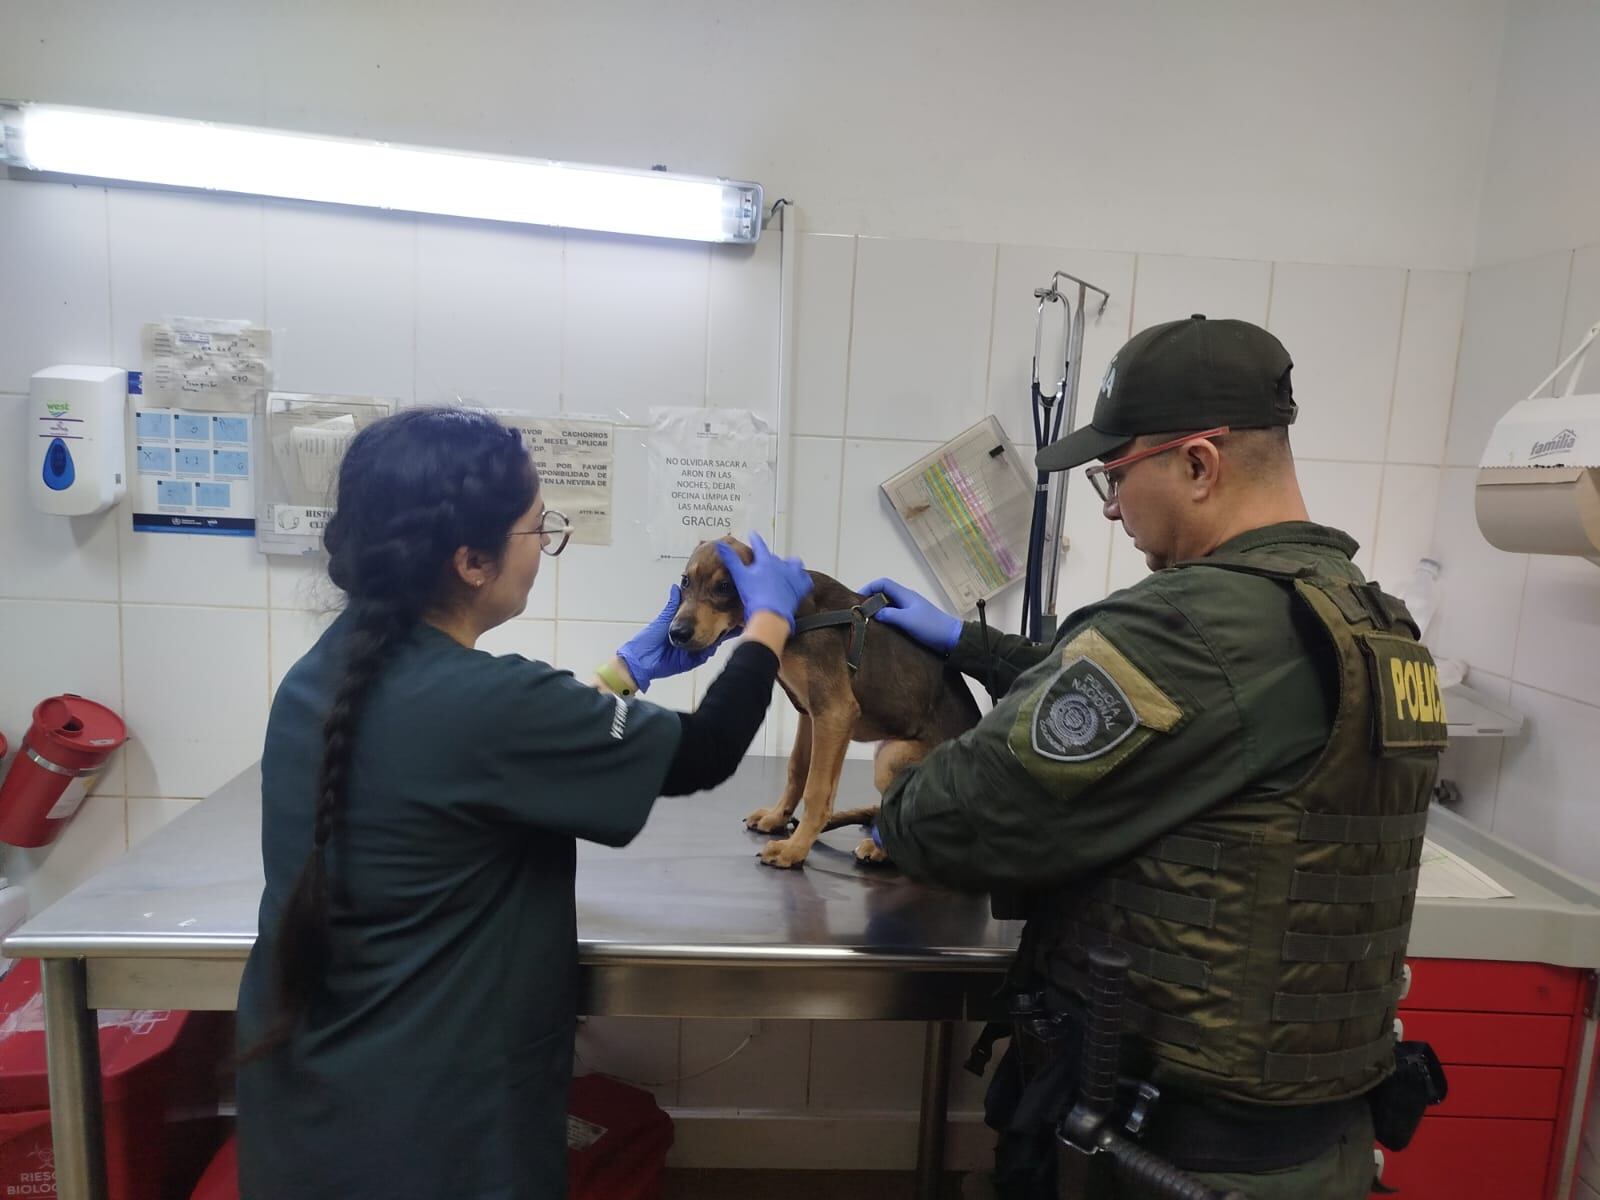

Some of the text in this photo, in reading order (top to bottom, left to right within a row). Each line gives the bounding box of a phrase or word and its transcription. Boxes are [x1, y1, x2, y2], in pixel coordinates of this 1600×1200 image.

[46, 402, 70, 411] west
[520, 428, 609, 439] AVOR CACHORROS
[576, 439, 608, 447] APLICAR
[1530, 433, 1575, 455] familia
[665, 457, 748, 469] NO OLVIDAR SACAR A
[681, 469, 732, 479] ARON EN LAS
[712, 481, 736, 491] DEJAR
[671, 491, 741, 502] OFCINA LIMPIA EN
[678, 501, 733, 512] LAS MAÑANAS
[306, 509, 333, 518] HISTO
[682, 515, 731, 528] GRACIAS
[1072, 678, 1120, 730] NACIONAL
